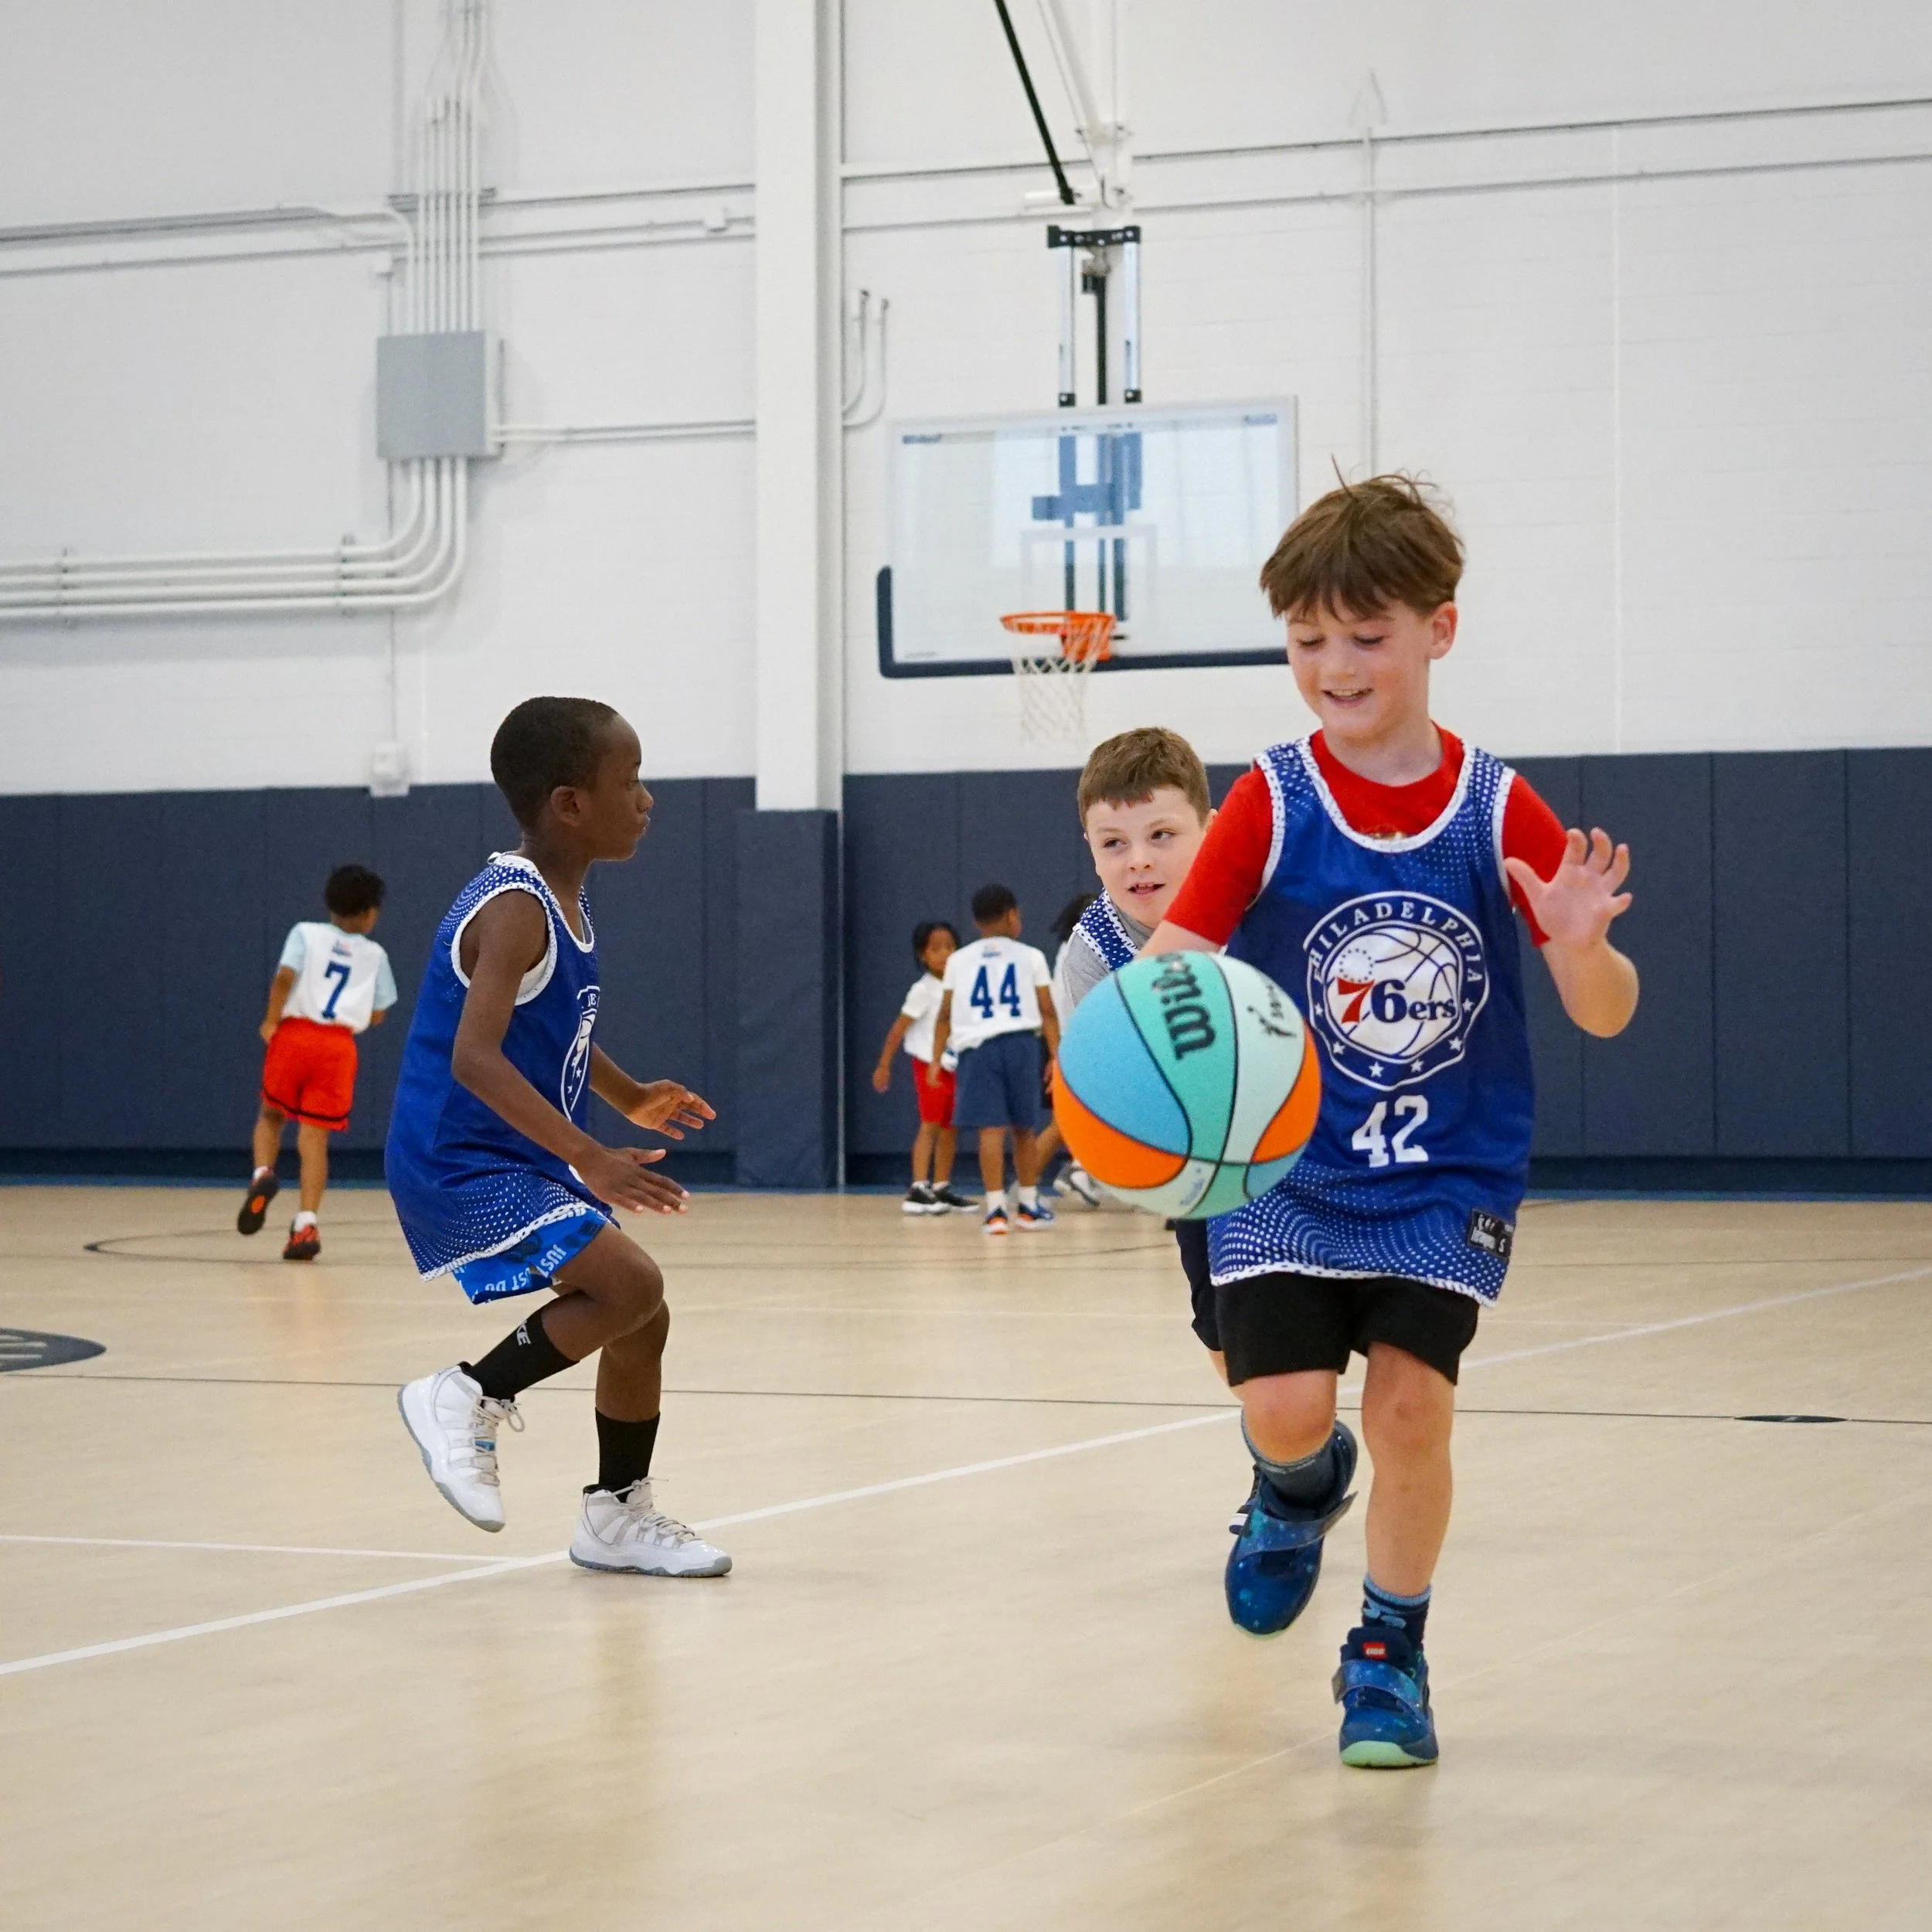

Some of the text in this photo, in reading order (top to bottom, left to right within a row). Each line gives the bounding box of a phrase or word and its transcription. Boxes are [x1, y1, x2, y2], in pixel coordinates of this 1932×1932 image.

[321, 961, 350, 1019] 7
[971, 962, 1021, 1018] 44
[1337, 977, 1457, 1025] 76ers
[1352, 1094, 1429, 1168] 42
